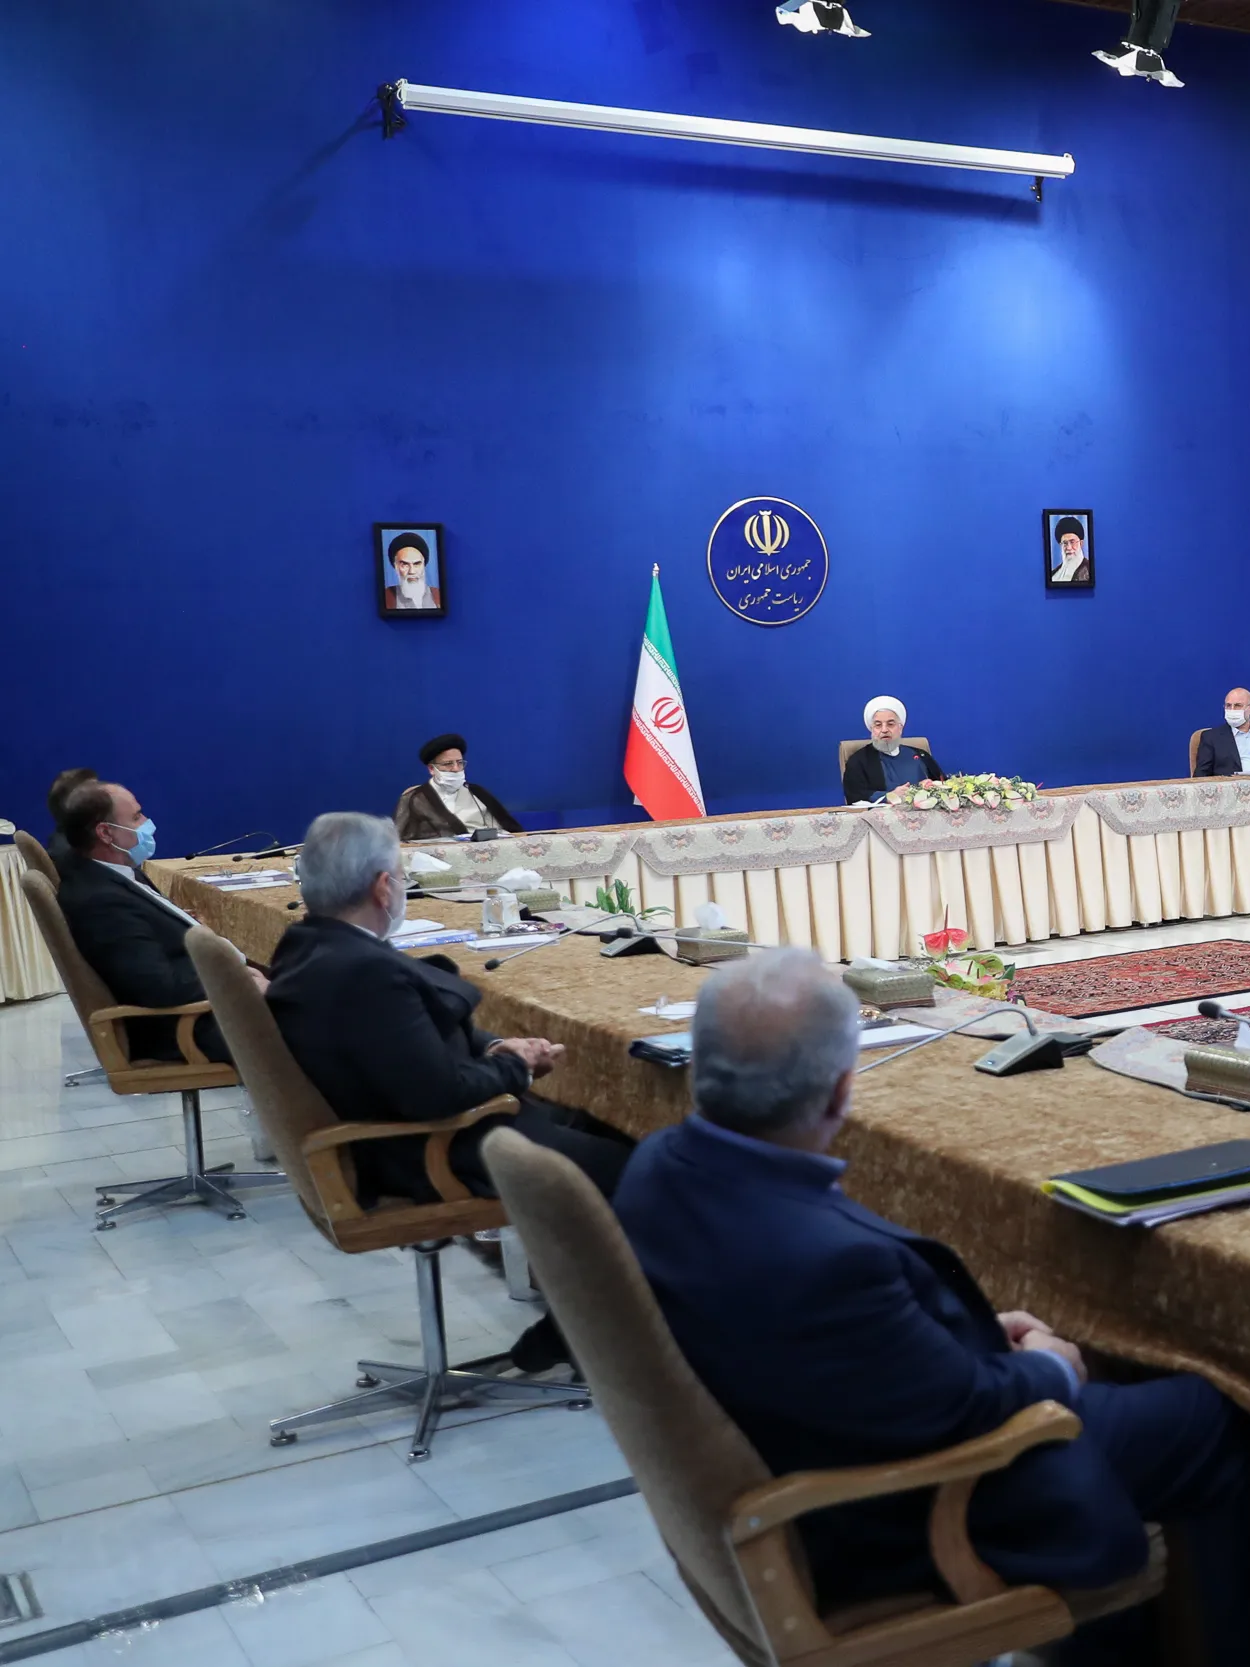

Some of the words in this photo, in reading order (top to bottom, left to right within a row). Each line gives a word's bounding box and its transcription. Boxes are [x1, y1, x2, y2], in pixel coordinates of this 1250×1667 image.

[726, 565, 751, 584] ایران
[751, 562, 779, 580] اسلامی
[780, 559, 812, 581] جمهوری
[738, 588, 772, 610] جمهوری
[772, 592, 803, 612] ریاست
